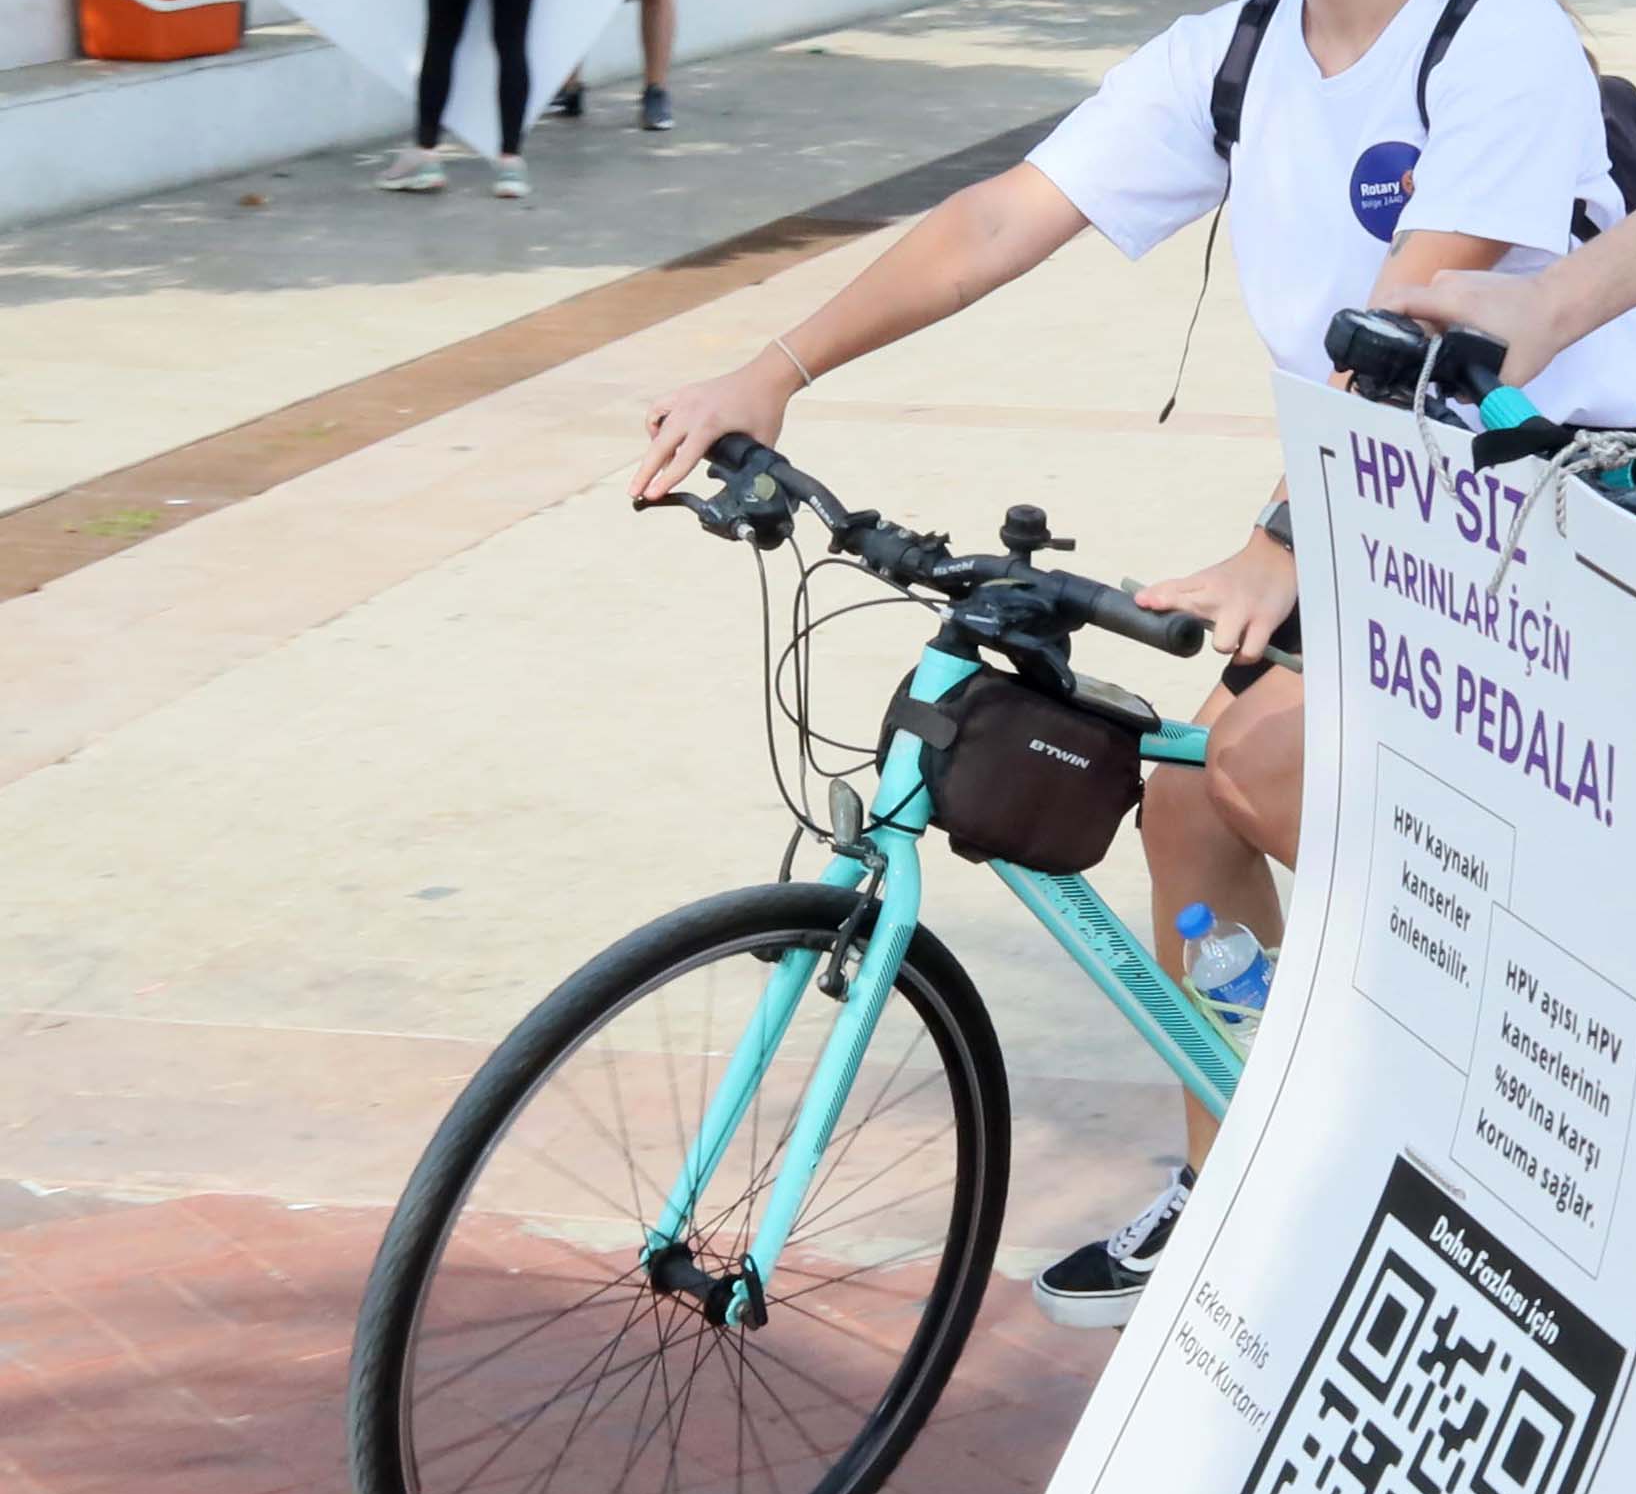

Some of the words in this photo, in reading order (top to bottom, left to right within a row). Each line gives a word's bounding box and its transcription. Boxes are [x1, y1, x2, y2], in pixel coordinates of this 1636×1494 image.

[1360, 181, 1400, 197] Rotary
[1361, 532, 1499, 645] YARINLAR
[1508, 584, 1571, 681] İÇİN
[1368, 618, 1443, 721] BAS
[1455, 663, 1615, 828] PEDALA!
[1394, 805, 1423, 846] HPV
[1426, 823, 1489, 892] kaynaklı
[1402, 860, 1471, 932] kanserler
[1390, 905, 1470, 988] önlenebilir.
[1506, 960, 1539, 1004] HPV
[1541, 987, 1581, 1041] aşısı,
[1587, 1017, 1623, 1064] HPV
[1501, 1011, 1610, 1117] kanserlerinin
[1476, 1107, 1538, 1179] koruma
[1542, 1161, 1595, 1228] sağlar.
[1558, 1111, 1601, 1171] karşı
[1429, 1215, 1473, 1268] Daha
[1469, 1250, 1529, 1317] Fazlası
[1175, 1320, 1217, 1375] Hayat
[1212, 1360, 1271, 1433] Kurtarır!
[1195, 1281, 1232, 1333] Erken
[1230, 1315, 1270, 1370] Teşhis
